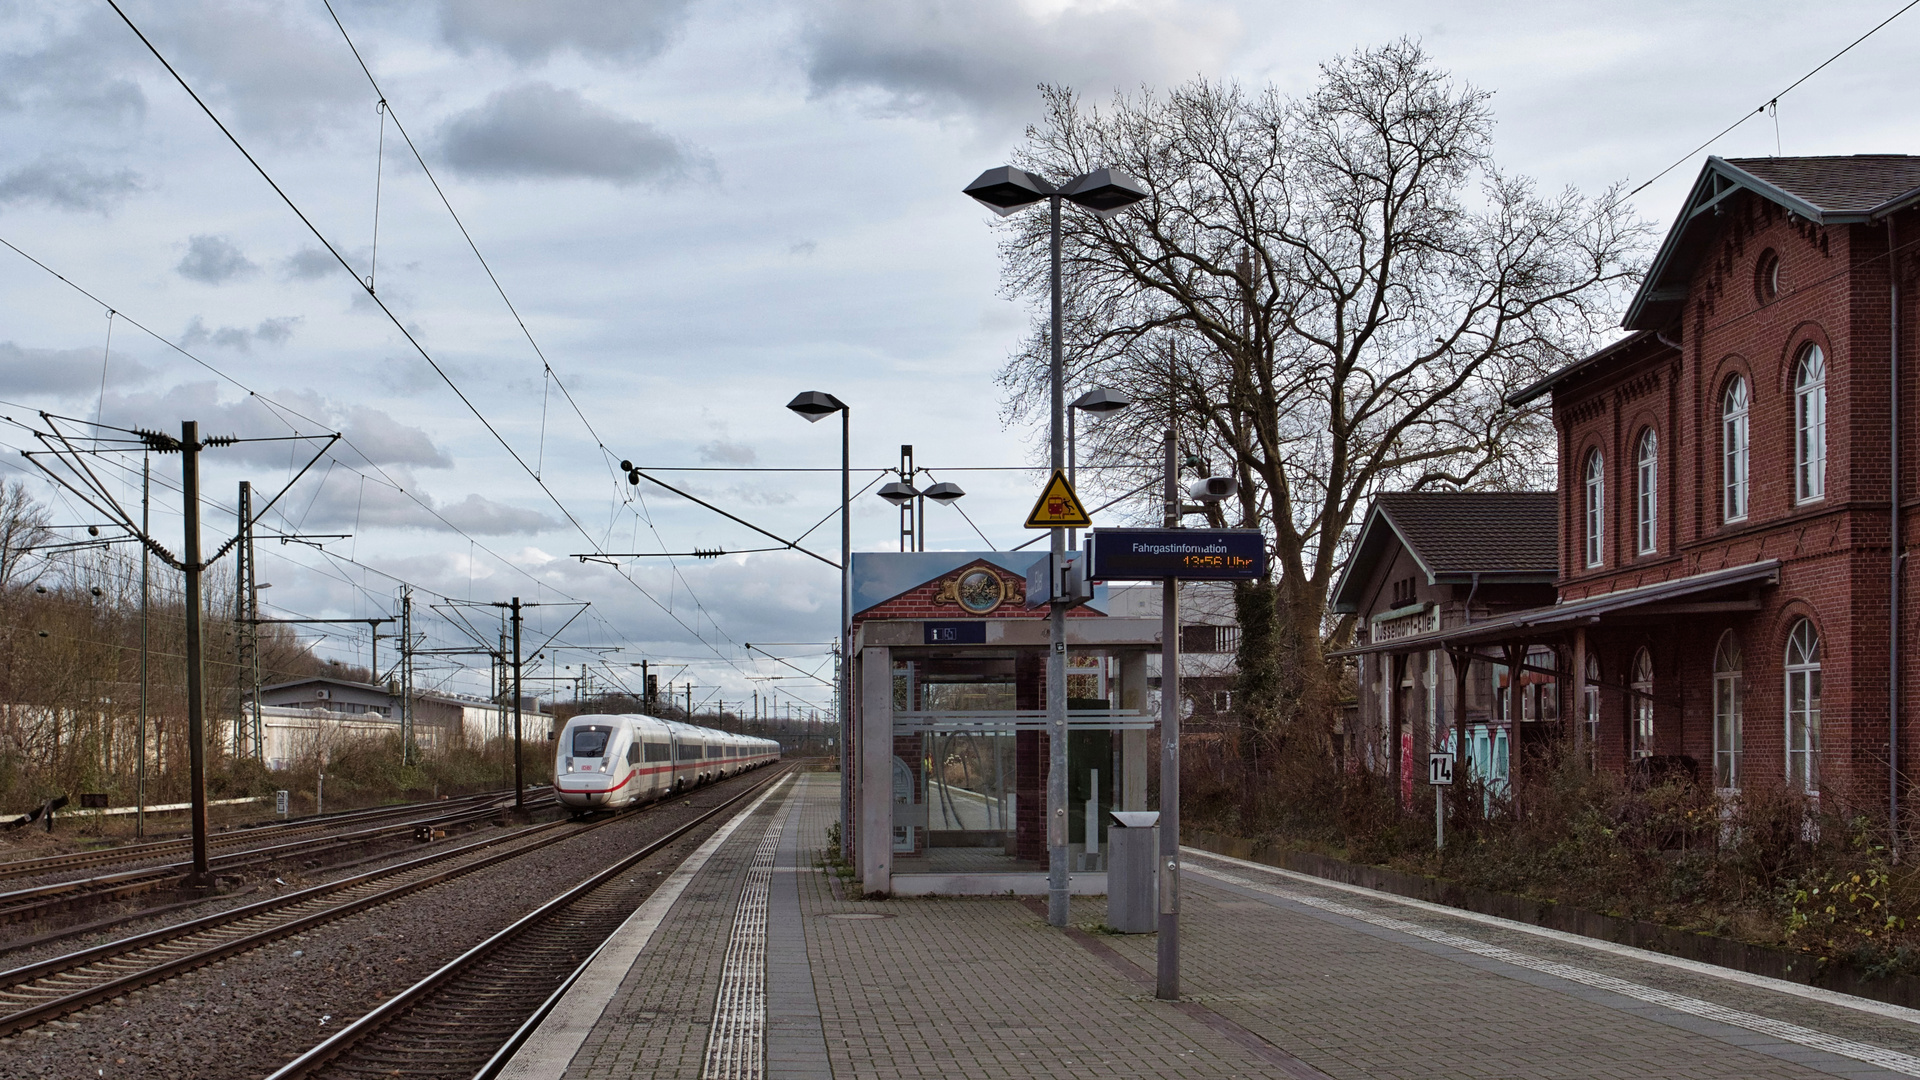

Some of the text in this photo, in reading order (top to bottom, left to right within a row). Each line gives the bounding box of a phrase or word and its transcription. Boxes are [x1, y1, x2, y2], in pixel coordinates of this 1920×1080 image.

[1132, 543, 1227, 554] Fahrgastinformation
[1183, 555, 1253, 568] 13:56 Uhr
[1431, 757, 1451, 780] 14
